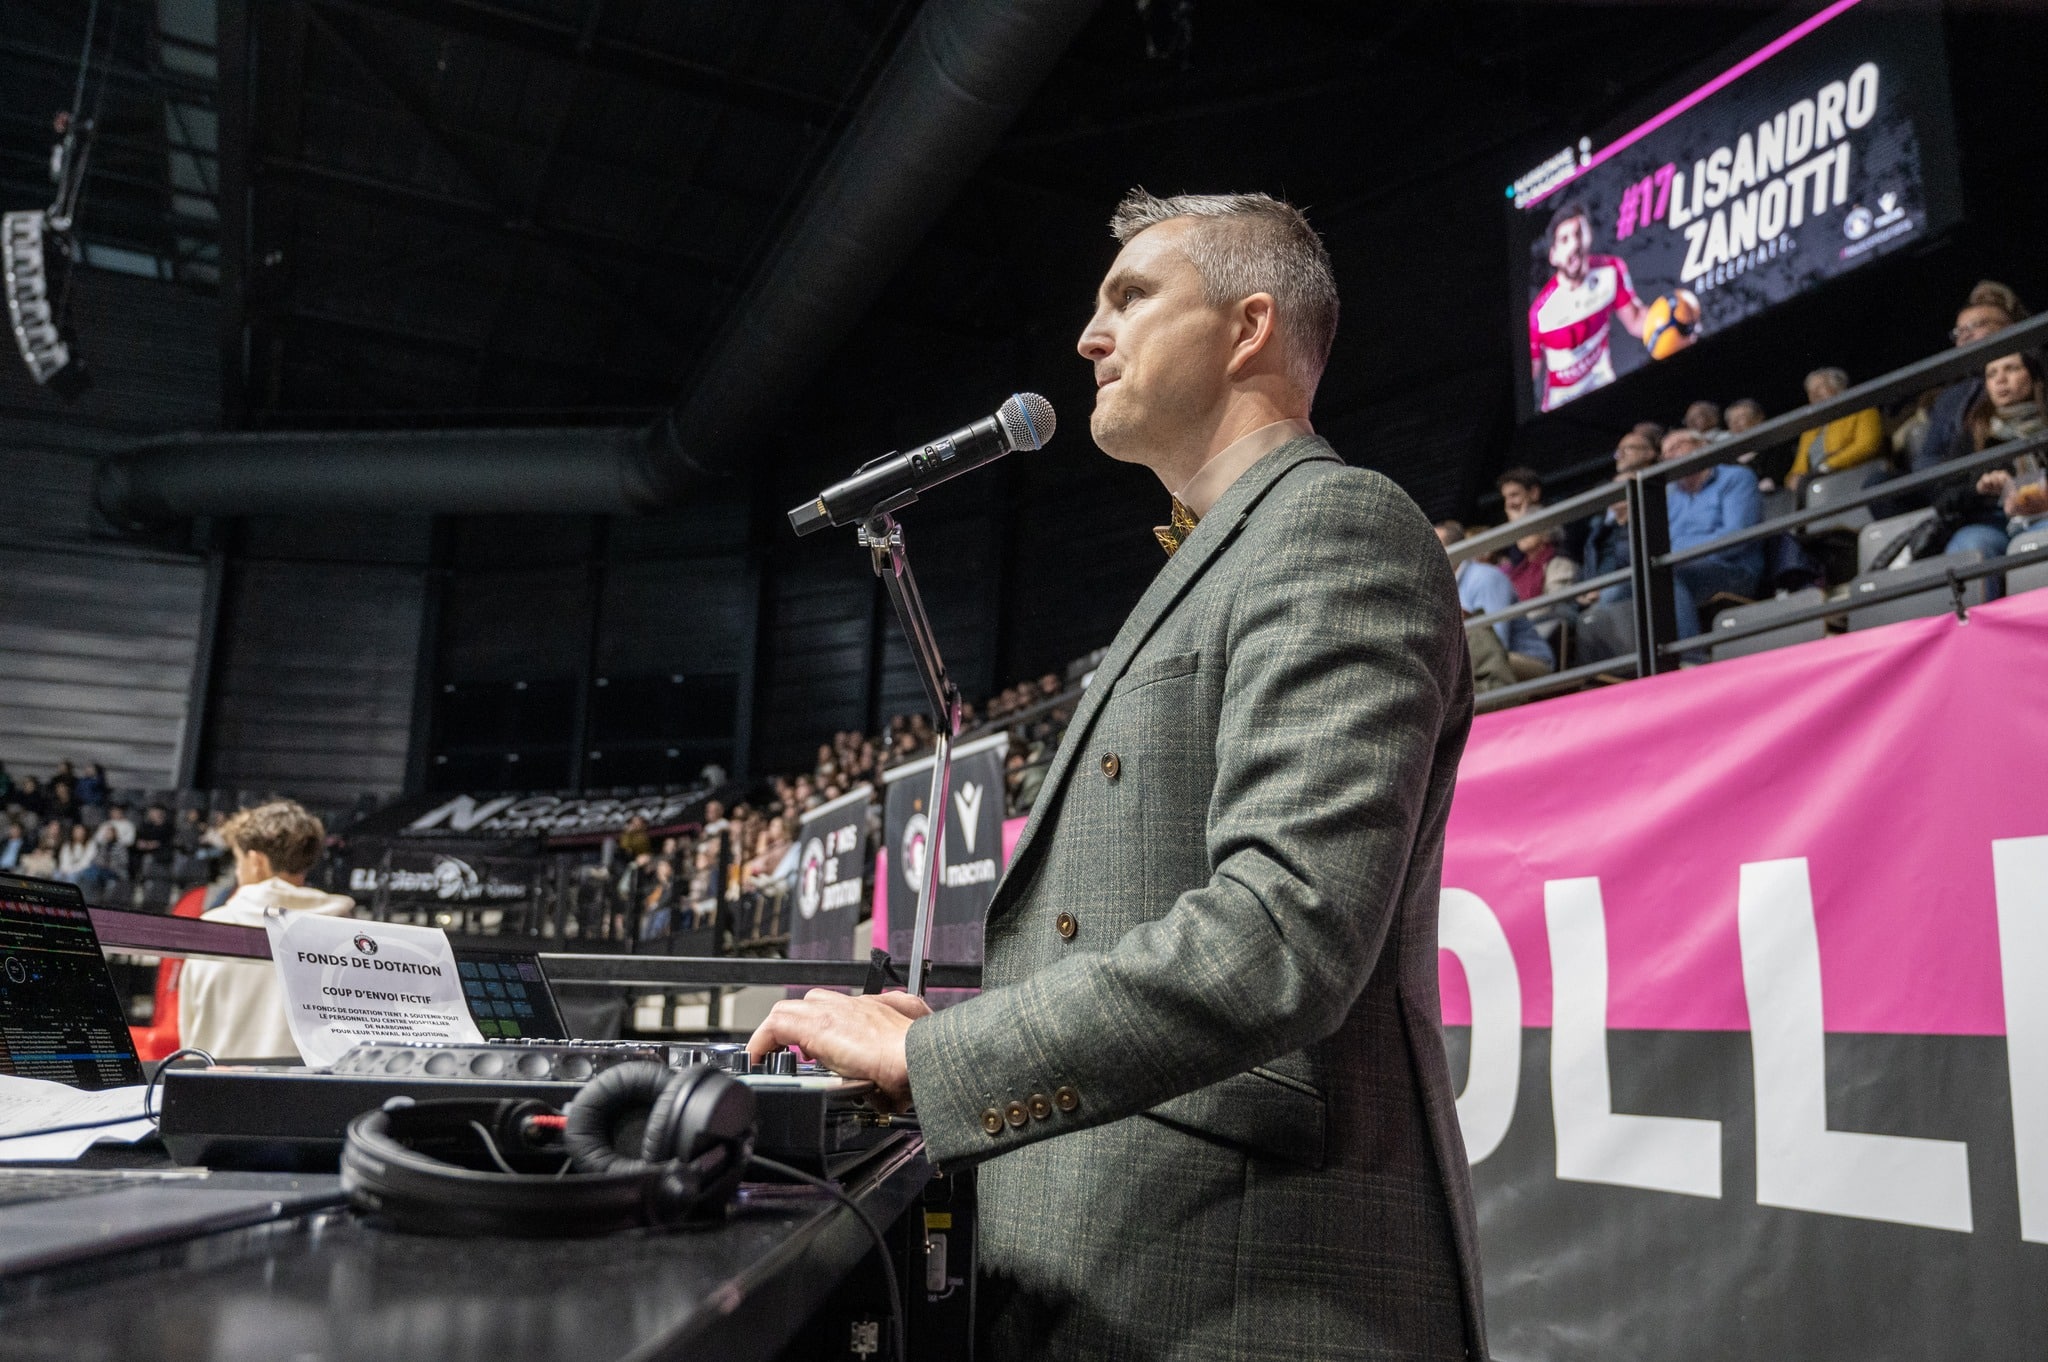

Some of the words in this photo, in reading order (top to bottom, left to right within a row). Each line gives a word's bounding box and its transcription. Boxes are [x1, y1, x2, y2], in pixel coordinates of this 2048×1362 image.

[1616, 163, 1676, 241] #17
[1669, 62, 1879, 230] LISANDRO
[1681, 141, 1852, 283] ZANOTTI
[297, 952, 348, 967] FONDS
[351, 957, 371, 969] DE
[374, 959, 442, 976] DOTATION
[323, 986, 352, 997] COUP
[355, 989, 398, 1001] D'ENVOI
[400, 994, 432, 1005] FICTIF
[312, 1005, 337, 1013] FONDS
[348, 1008, 383, 1016] DOTATION
[329, 1014, 370, 1023] PERSONNEL
[372, 1029, 401, 1037] TRAVAIL
